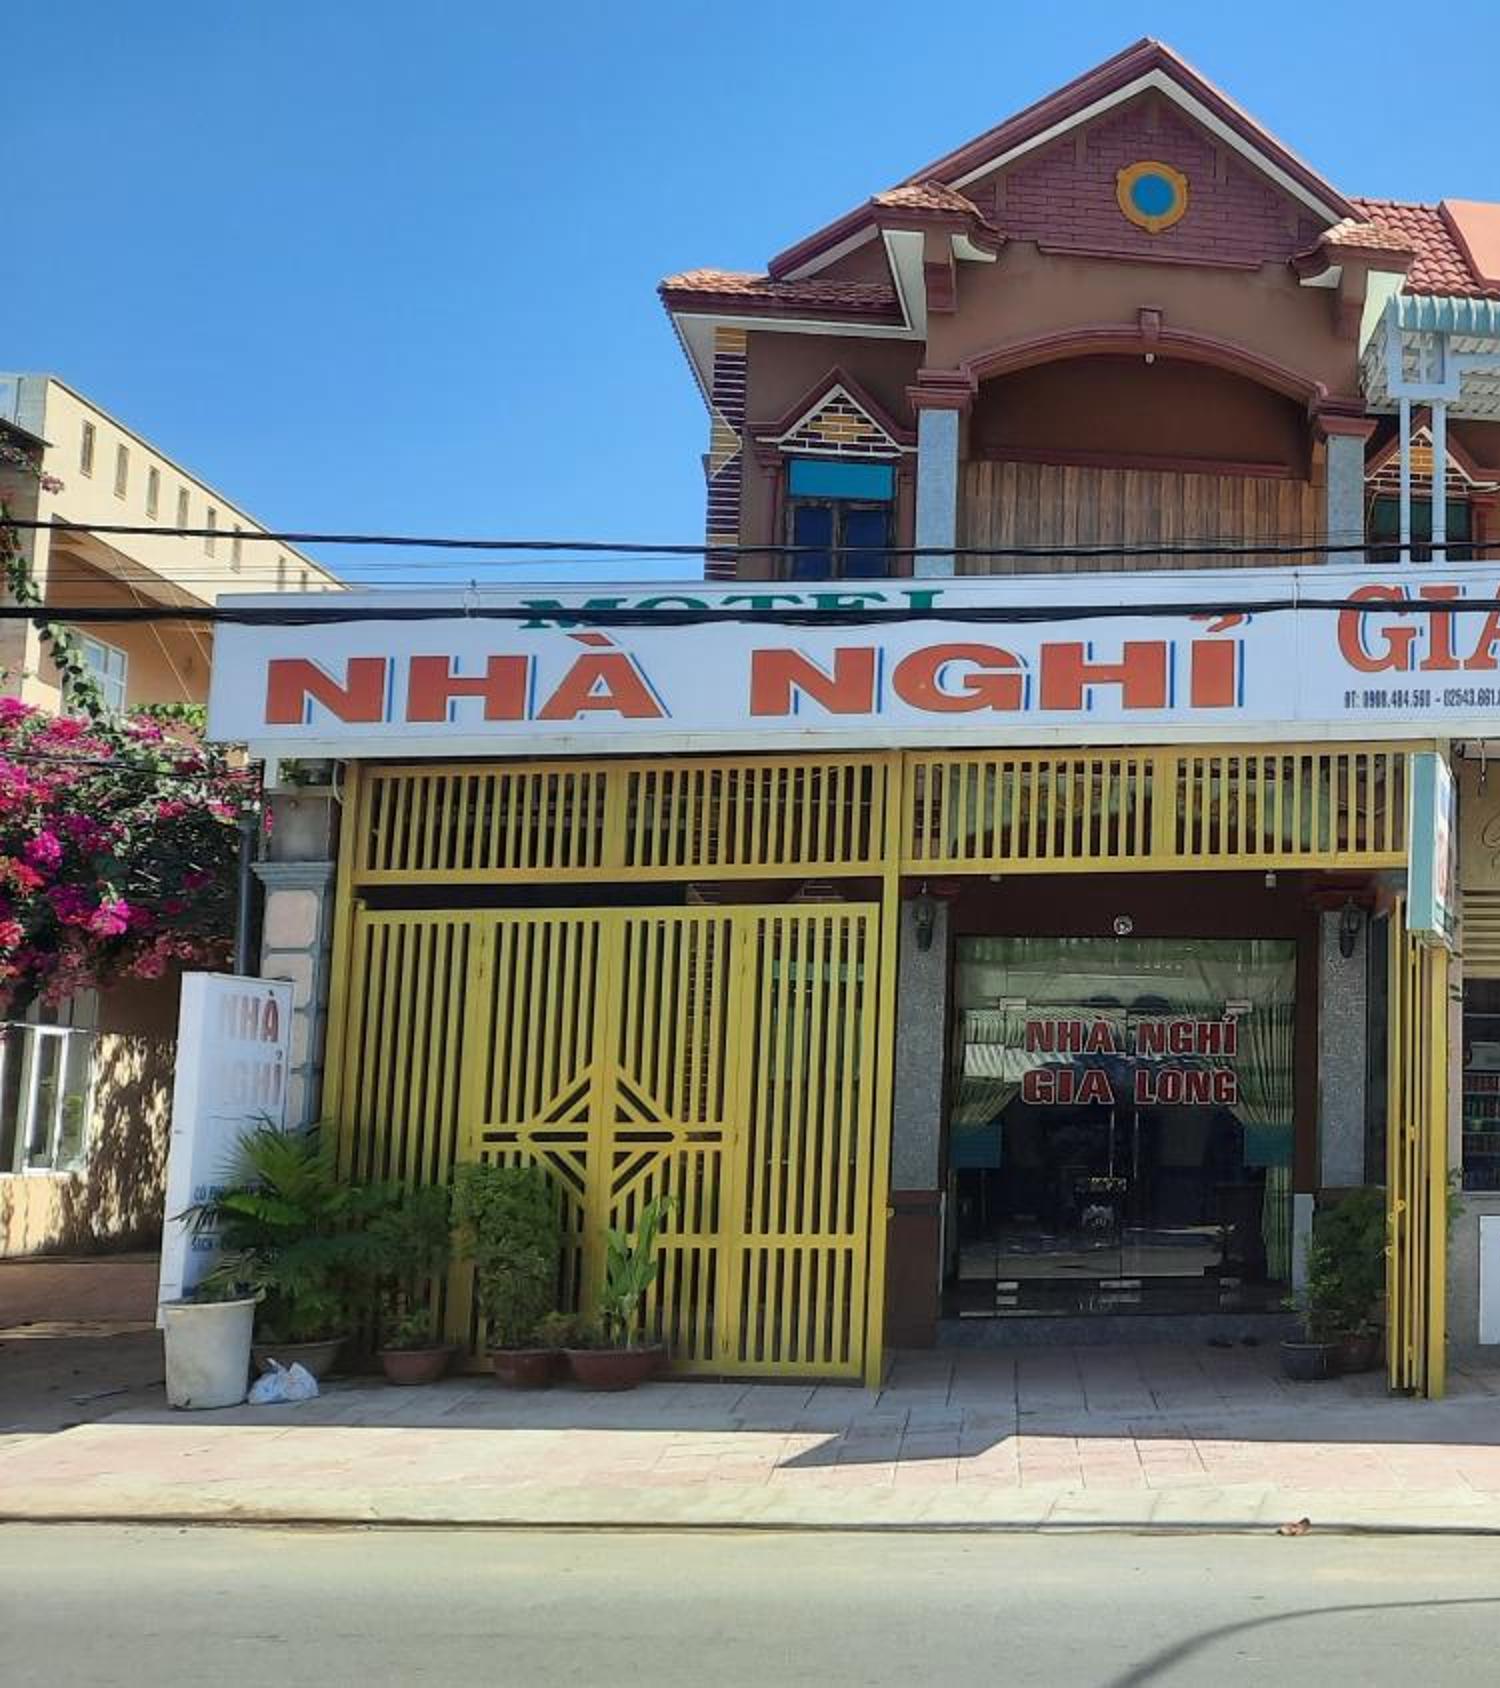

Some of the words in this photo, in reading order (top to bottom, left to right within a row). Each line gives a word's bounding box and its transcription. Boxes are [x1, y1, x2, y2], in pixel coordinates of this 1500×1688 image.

[265, 633, 671, 725] NHÀ
[1025, 1014, 1117, 1054] NHÀ
[1134, 1013, 1238, 1056] NGHỈ
[1022, 1069, 1115, 1105] GIA
[1134, 1066, 1238, 1105] LONG
